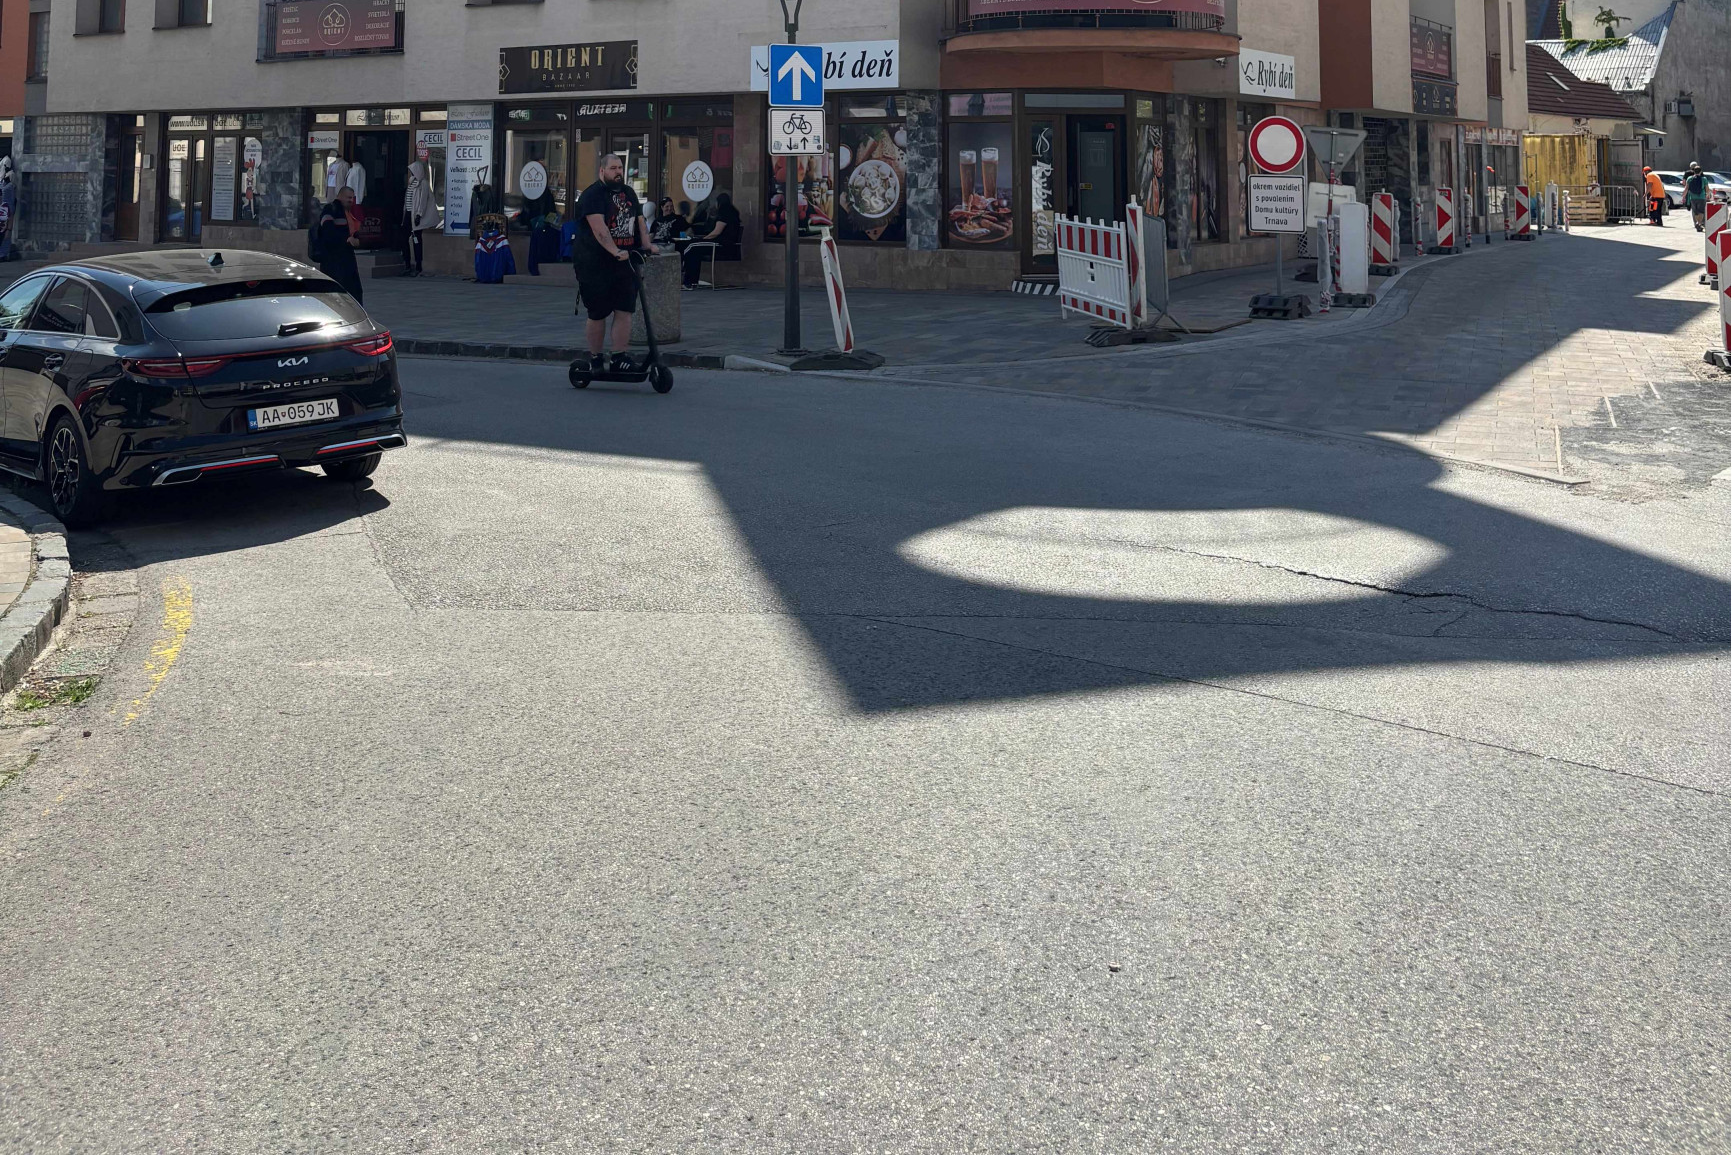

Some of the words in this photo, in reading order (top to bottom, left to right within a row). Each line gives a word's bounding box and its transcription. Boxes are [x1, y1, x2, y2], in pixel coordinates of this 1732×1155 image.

[530, 46, 605, 71] ORIENT
[851, 49, 894, 79] deň
[542, 71, 590, 81] BAZAAR
[1257, 59, 1277, 94] Rybí
[1278, 63, 1293, 90] deň
[450, 121, 473, 130] DÁMSKA
[474, 120, 490, 129] MÓDA
[423, 134, 444, 143] CECIL
[455, 147, 483, 159] CECIL
[1034, 160, 1055, 208] Rybí
[1252, 182, 1274, 191] okrem
[1274, 182, 1301, 192] vozidiel
[1255, 205, 1274, 214] Domu
[1274, 206, 1299, 216] kultúry
[1264, 216, 1288, 226] Trnava
[277, 356, 309, 367] KIA
[262, 408, 281, 424] AA
